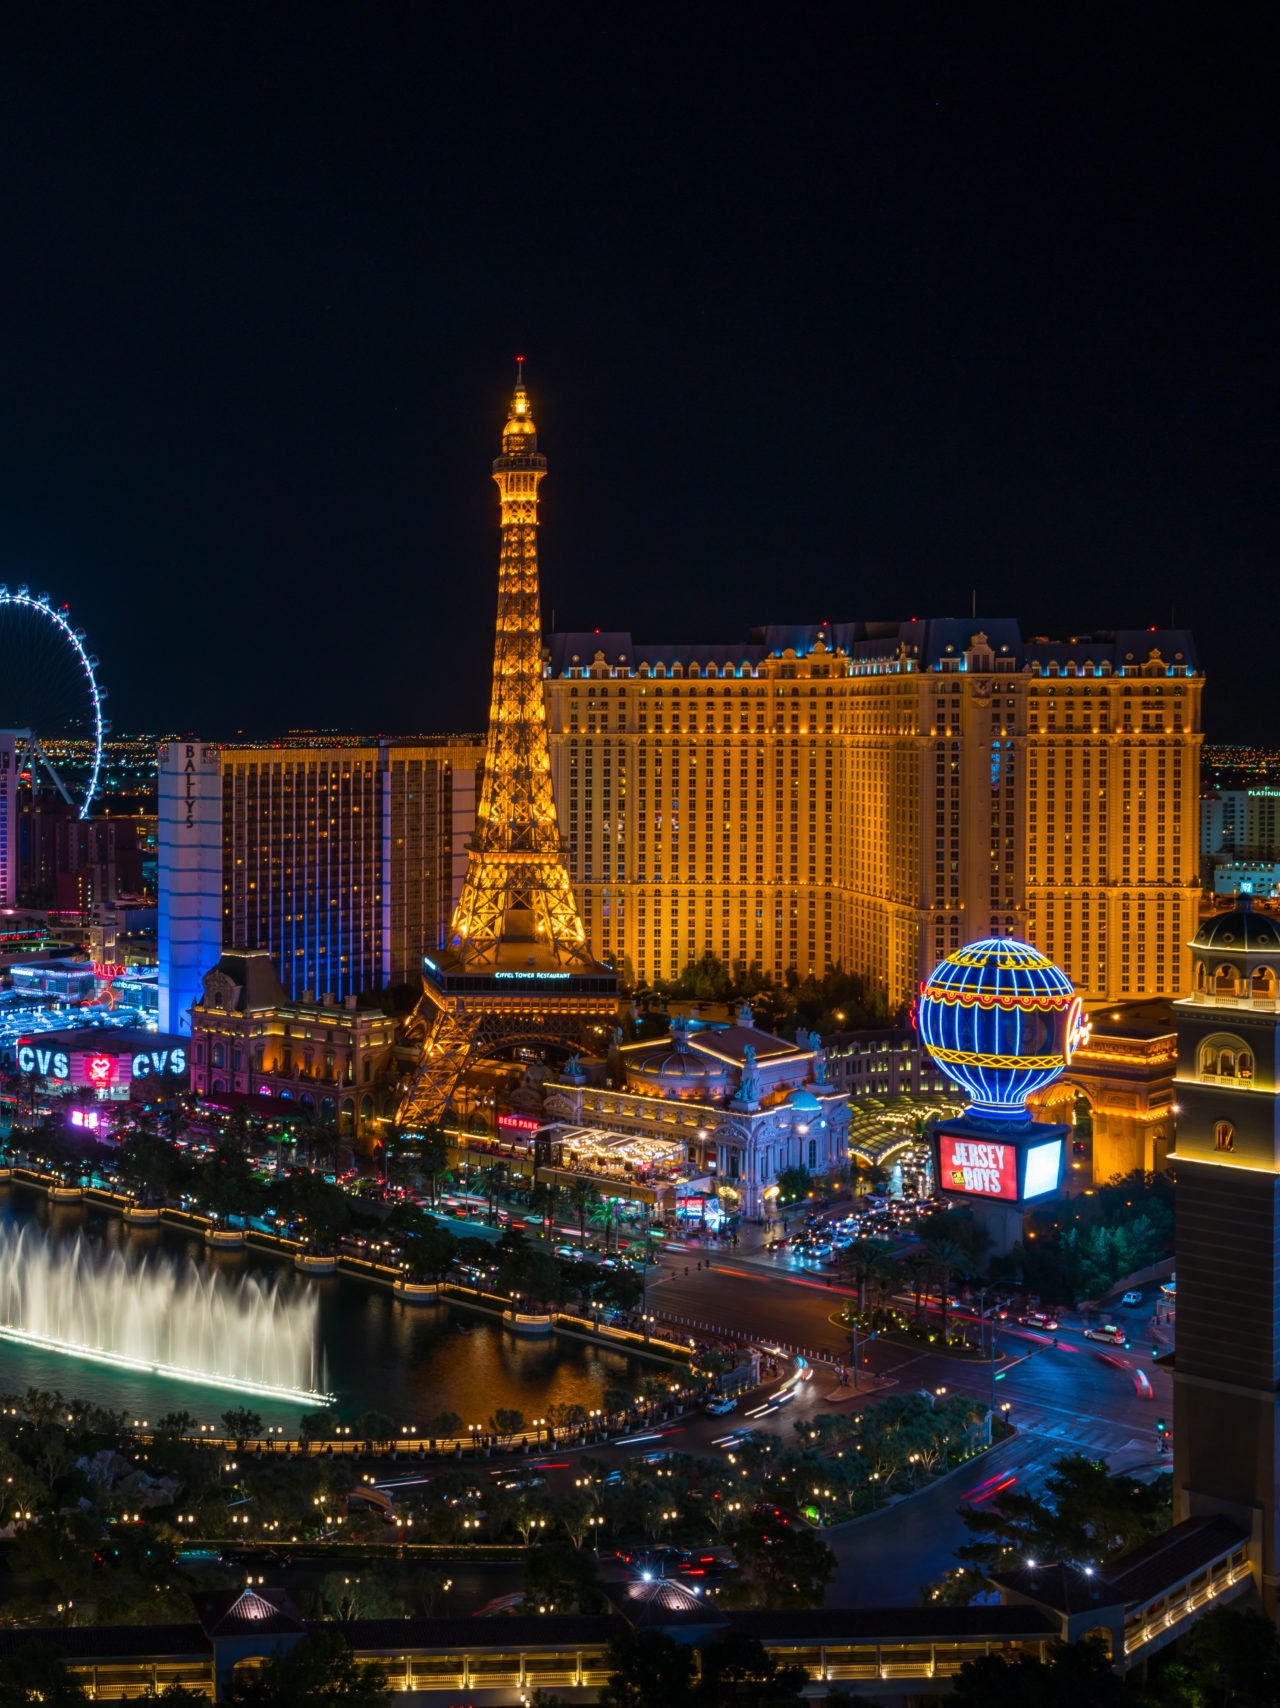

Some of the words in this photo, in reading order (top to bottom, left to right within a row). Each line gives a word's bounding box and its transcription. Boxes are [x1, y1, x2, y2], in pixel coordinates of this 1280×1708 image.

[19, 1047, 68, 1078] CVS
[132, 1049, 186, 1079] CVS
[498, 1117, 516, 1126] BEER
[518, 1120, 538, 1130] PARK
[952, 1142, 1004, 1169] JERSEY
[963, 1167, 1001, 1193] BOYS
